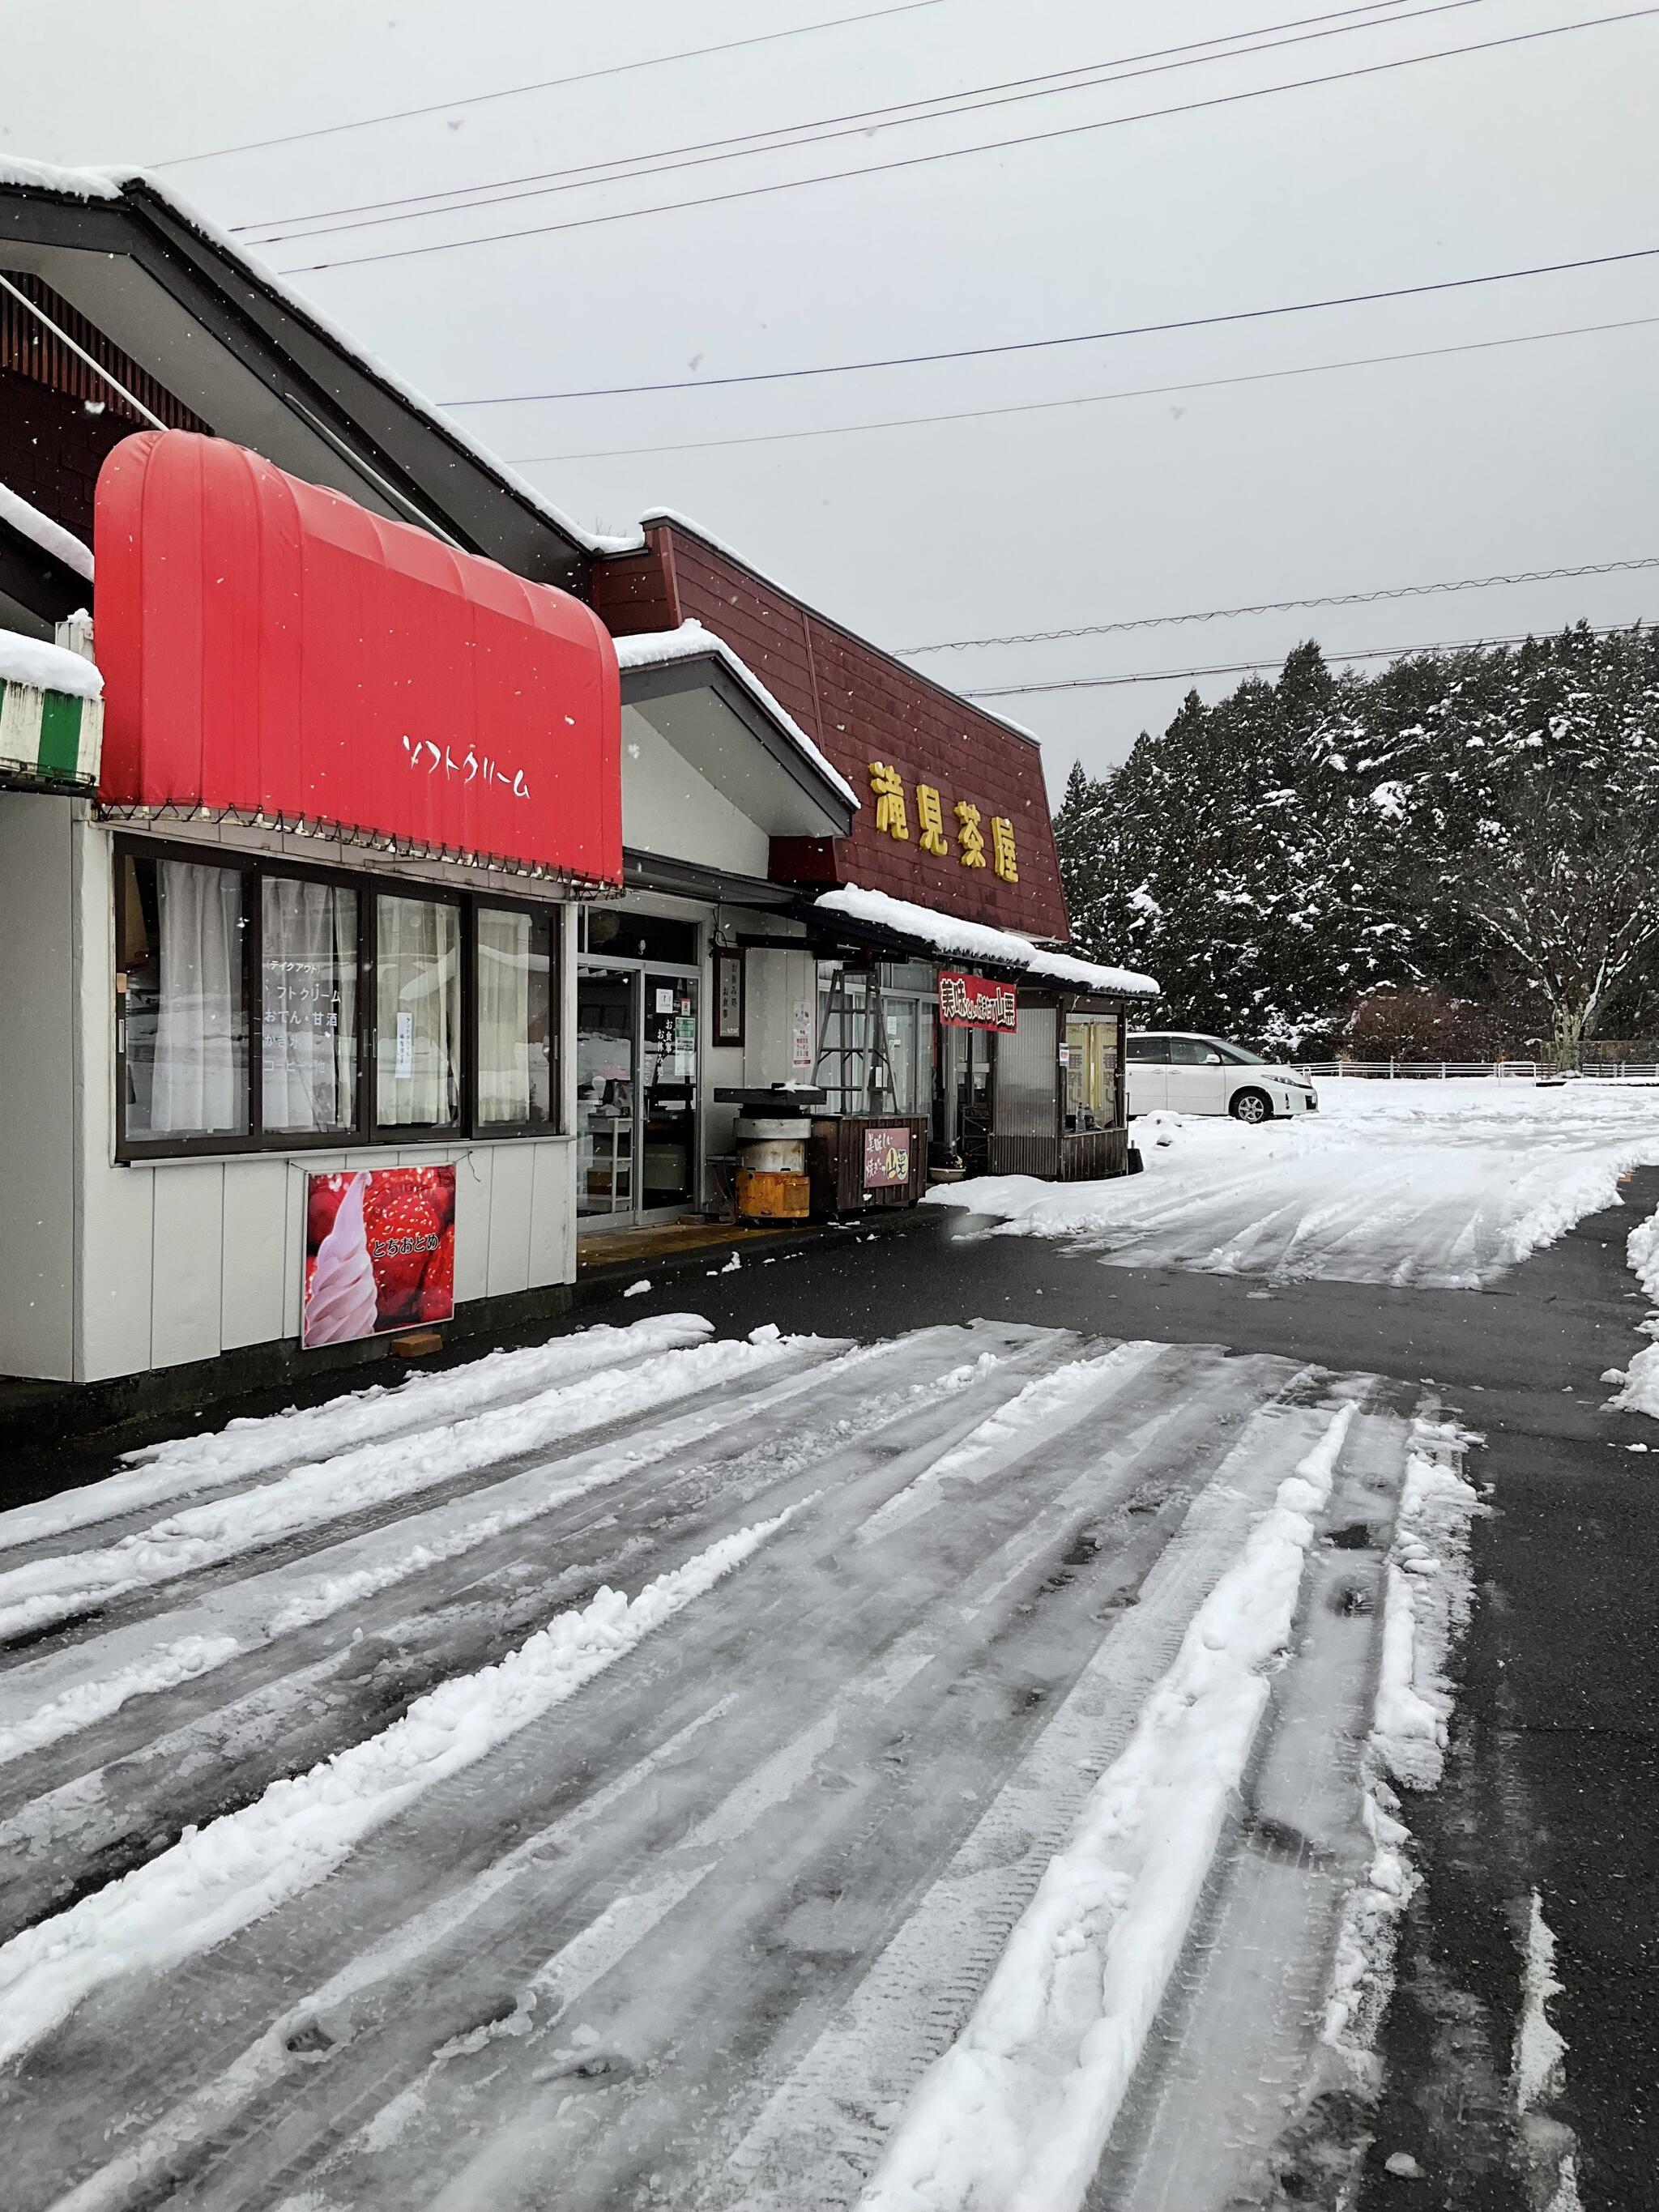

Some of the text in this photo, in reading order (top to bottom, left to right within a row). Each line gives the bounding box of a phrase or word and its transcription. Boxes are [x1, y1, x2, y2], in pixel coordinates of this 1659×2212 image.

[403, 735, 530, 799] ソフトクリーム
[373, 1233, 439, 1257] とちおとめ
